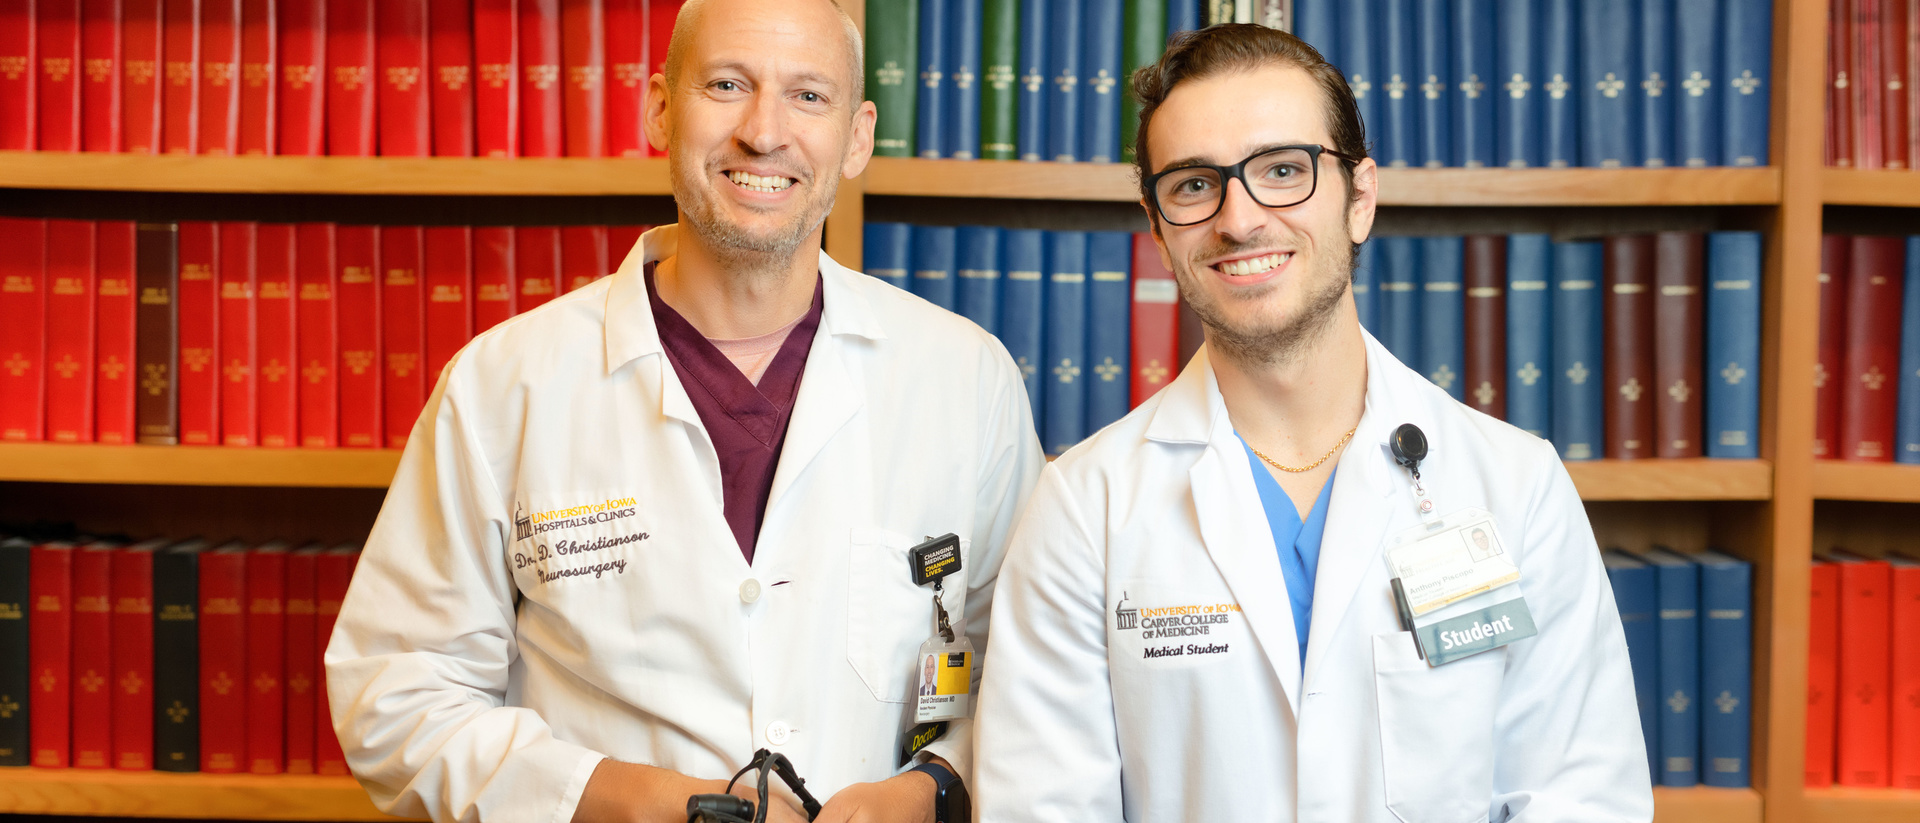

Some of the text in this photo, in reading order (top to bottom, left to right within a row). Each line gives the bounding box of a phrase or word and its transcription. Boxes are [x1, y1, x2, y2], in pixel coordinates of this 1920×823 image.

[532, 497, 637, 523] UNIVERSITY OF IOWA
[534, 517, 588, 535] HOSPITALS
[596, 508, 636, 523] CLINICS
[514, 531, 650, 569] Dr. D. Christianson
[924, 544, 954, 560] CHANGING
[924, 551, 954, 566] MEDICINE.
[925, 556, 955, 572] CHANGING
[538, 558, 627, 585] Neurosurgery
[925, 567, 944, 578] LIVES.
[1410, 578, 1442, 595] Anthony
[1140, 603, 1242, 618] UNIVERSITY OF IOW
[1141, 613, 1229, 629] CARVER COLLEGE
[1142, 625, 1210, 640] OF MEDICINE
[1440, 614, 1514, 650] Student
[1143, 643, 1229, 659] Medical Student
[911, 724, 939, 752] Doctor
